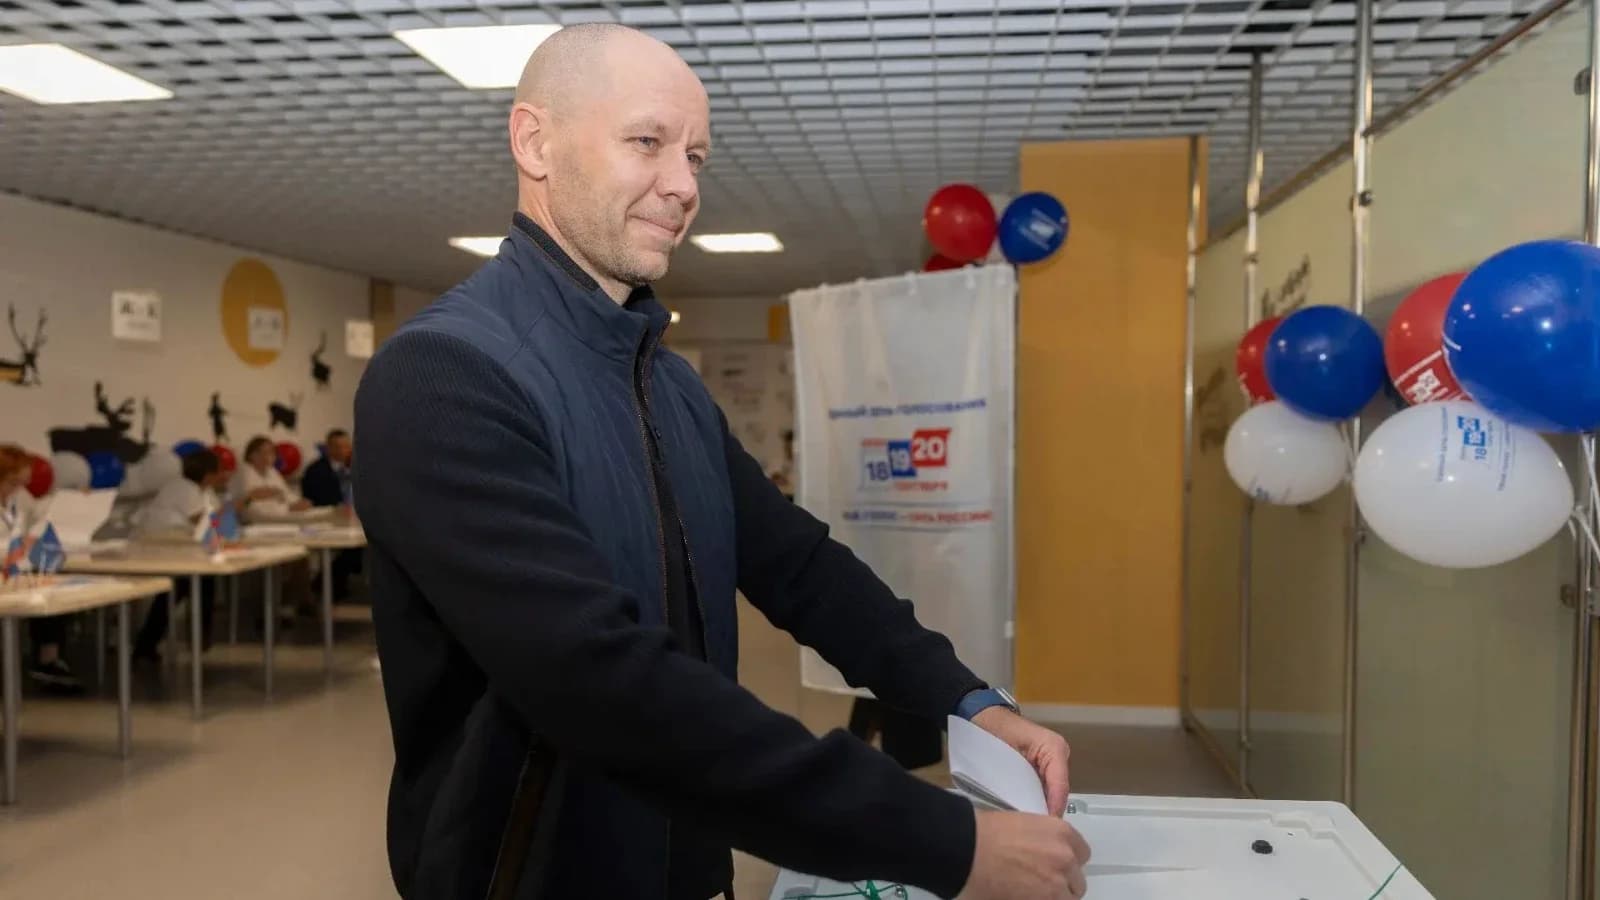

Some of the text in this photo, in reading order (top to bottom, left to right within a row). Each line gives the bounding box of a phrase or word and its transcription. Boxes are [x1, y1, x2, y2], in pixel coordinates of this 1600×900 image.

[866, 436, 944, 480] 18 19 20
[1474, 448, 1487, 460] 18
